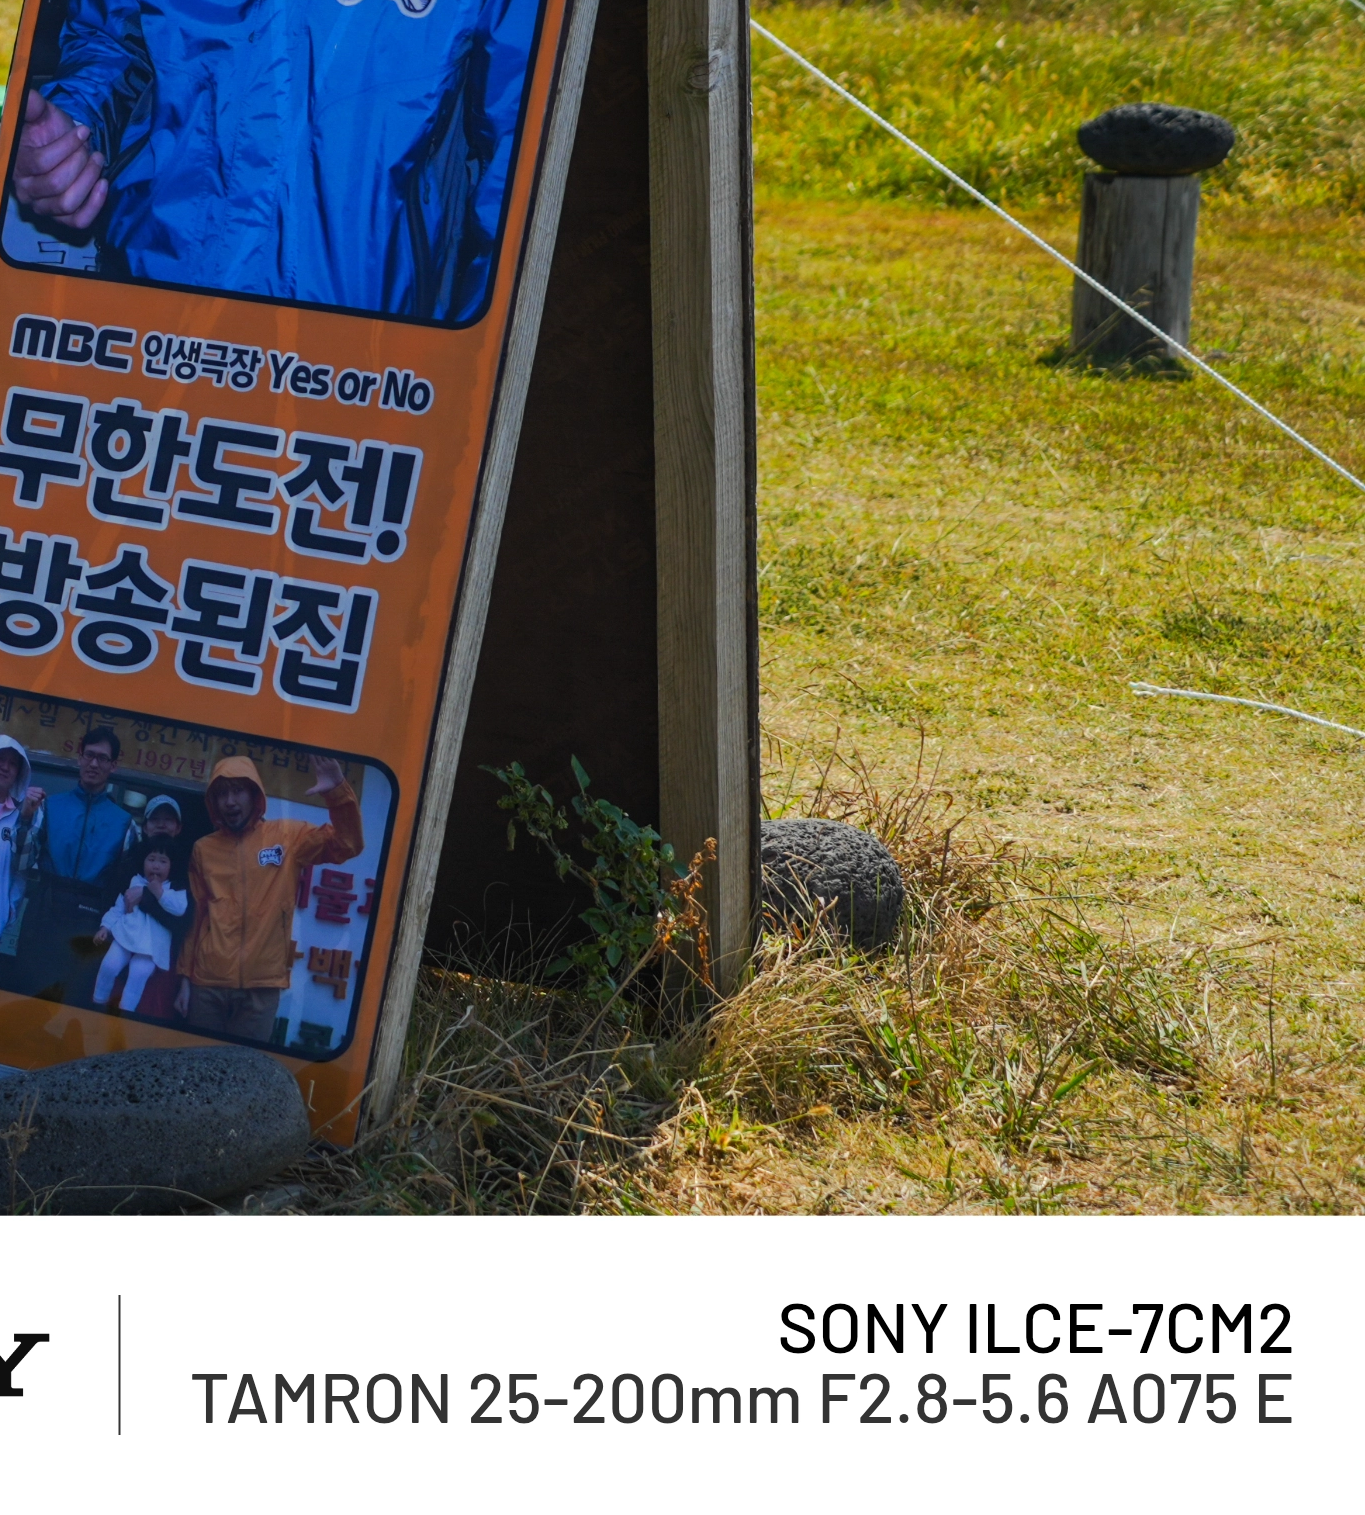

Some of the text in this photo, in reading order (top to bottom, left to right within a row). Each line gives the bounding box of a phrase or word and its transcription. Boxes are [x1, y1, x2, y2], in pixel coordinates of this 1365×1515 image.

[9, 316, 432, 413] MBC 인생극장 Yes or No
[63, 736, 207, 779] sie 1997년
